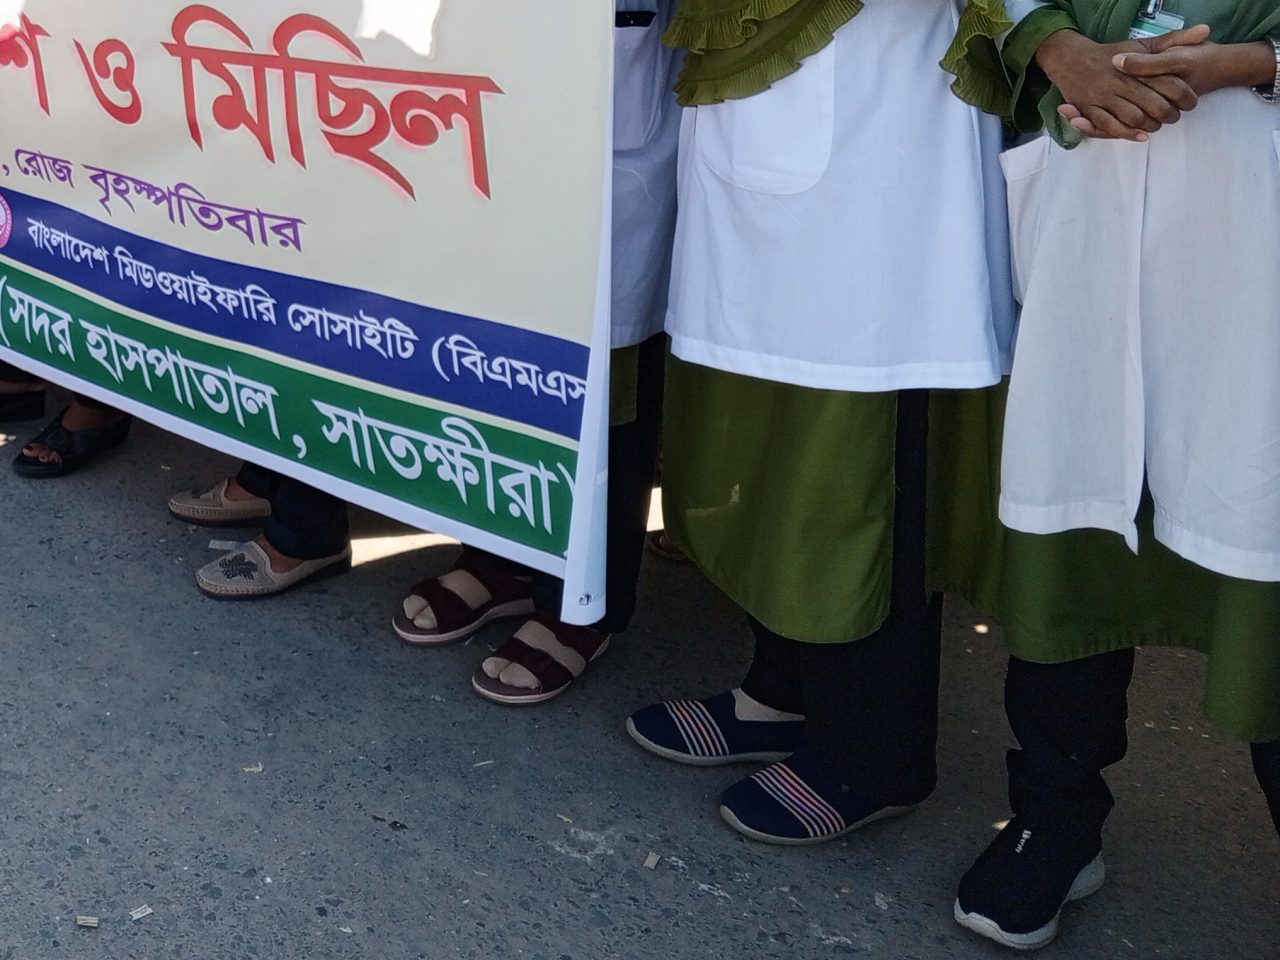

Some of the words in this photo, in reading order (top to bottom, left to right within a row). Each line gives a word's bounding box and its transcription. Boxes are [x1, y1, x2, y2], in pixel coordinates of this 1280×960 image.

[73, 38, 142, 125] ও
[160, 3, 506, 202] মিছিল
[14, 147, 76, 189] রোজ
[81, 163, 308, 253] বৃহস্পতিবার
[26, 216, 111, 276] বাংলাদেশ
[113, 245, 278, 327] মিডওয়াইফারি
[287, 302, 421, 361] সোসাইটি
[79, 316, 280, 441] হাসপাতাল
